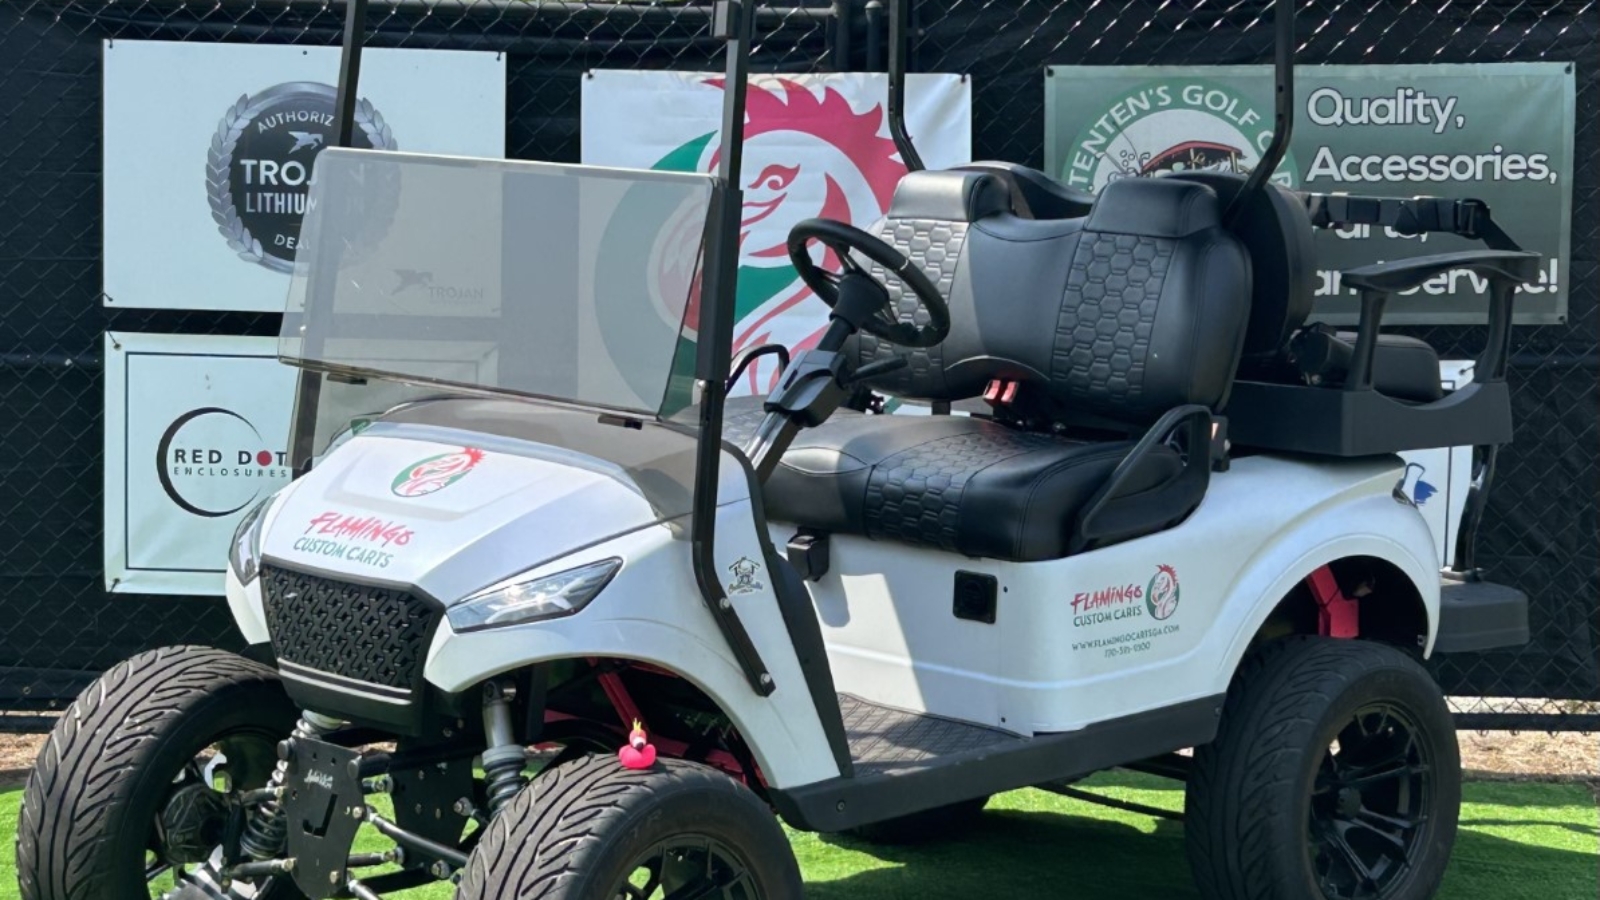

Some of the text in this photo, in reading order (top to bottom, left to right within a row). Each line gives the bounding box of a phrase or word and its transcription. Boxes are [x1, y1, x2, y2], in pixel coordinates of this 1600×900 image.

[1182, 85, 1260, 126] GOLF
[1306, 87, 1466, 134] Quality,
[257, 110, 335, 134] AUTHORIZ
[1306, 145, 1558, 185] Accessories,
[173, 466, 287, 477] ENCLOSURES
[174, 449, 287, 467] RED DOT
[293, 537, 394, 568] CUSTOM CARTS
[1073, 605, 1142, 627] CUSTOM CARTS
